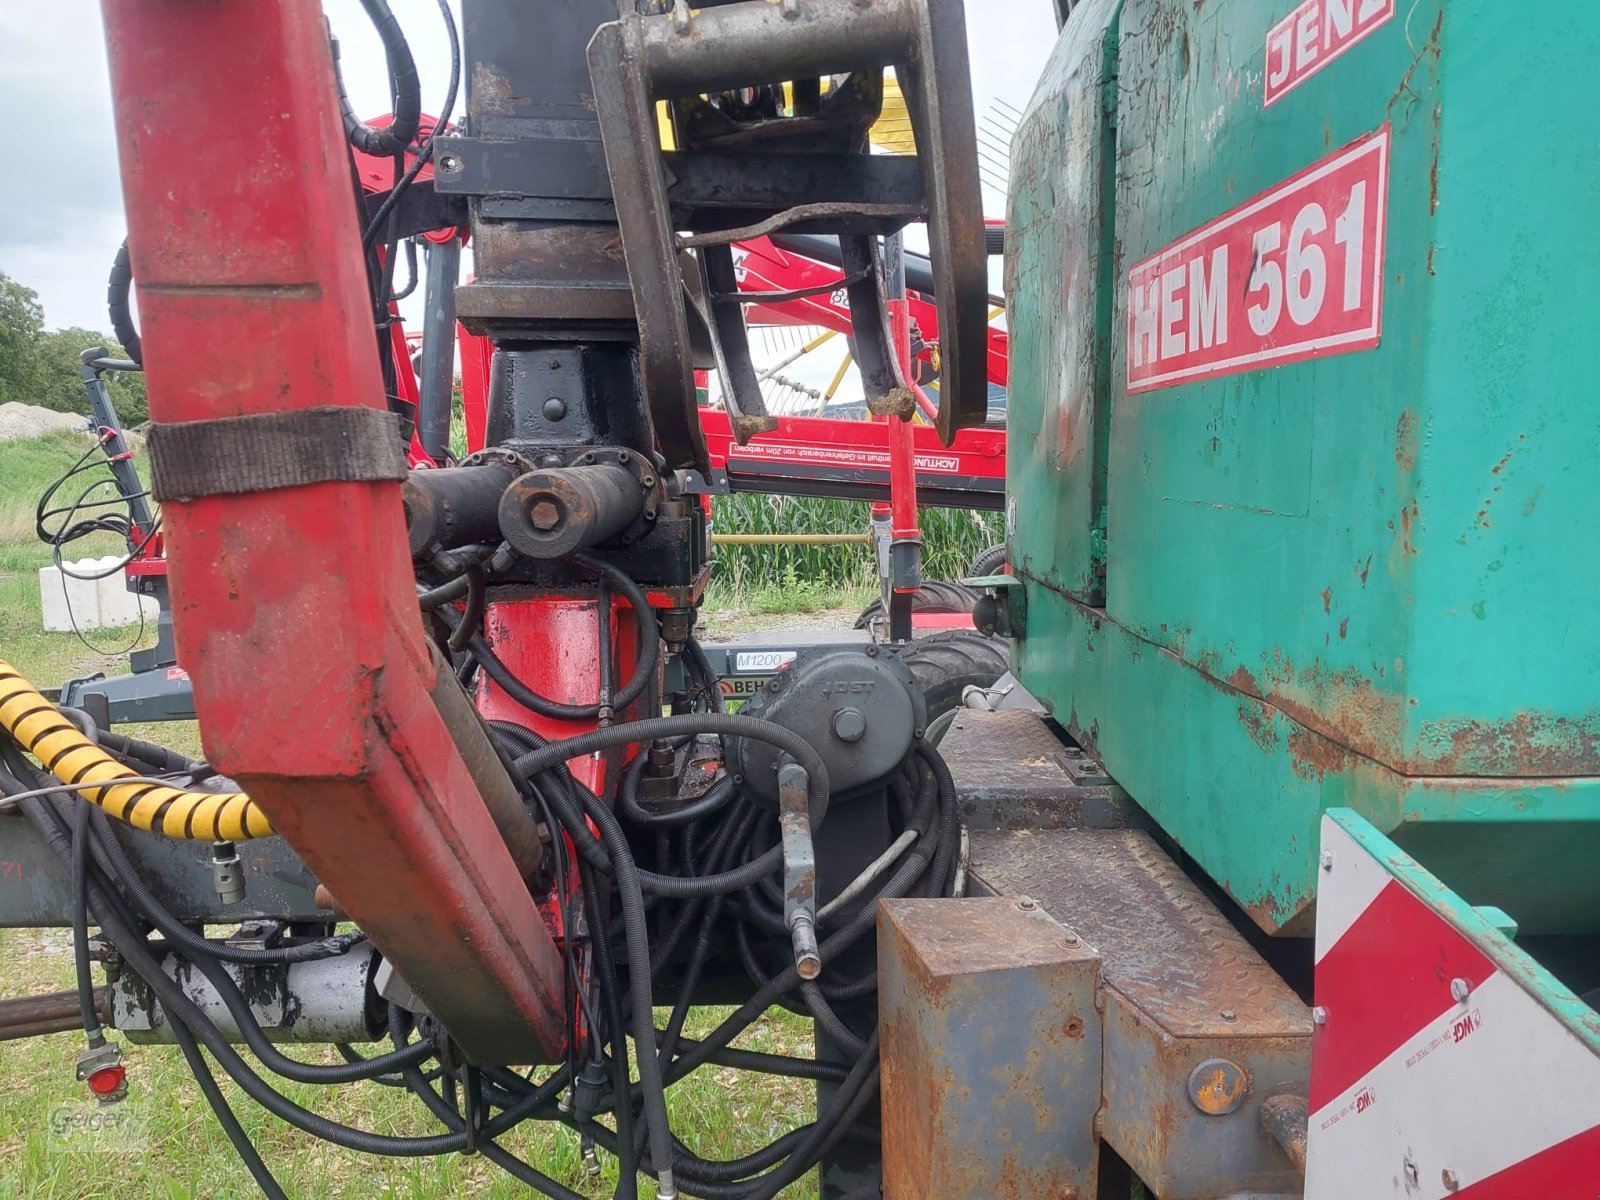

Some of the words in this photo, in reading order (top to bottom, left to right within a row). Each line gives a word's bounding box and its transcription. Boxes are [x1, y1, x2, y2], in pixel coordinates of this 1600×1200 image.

[1133, 243, 1229, 368] HEM
[1247, 179, 1366, 337] 561
[765, 447, 782, 455] 20m
[798, 449, 855, 461] Gefahrenbereich
[738, 654, 782, 667] M1200
[734, 680, 765, 693] BEH
[1453, 1015, 1475, 1044] WGF
[1356, 1091, 1371, 1114] WGF
